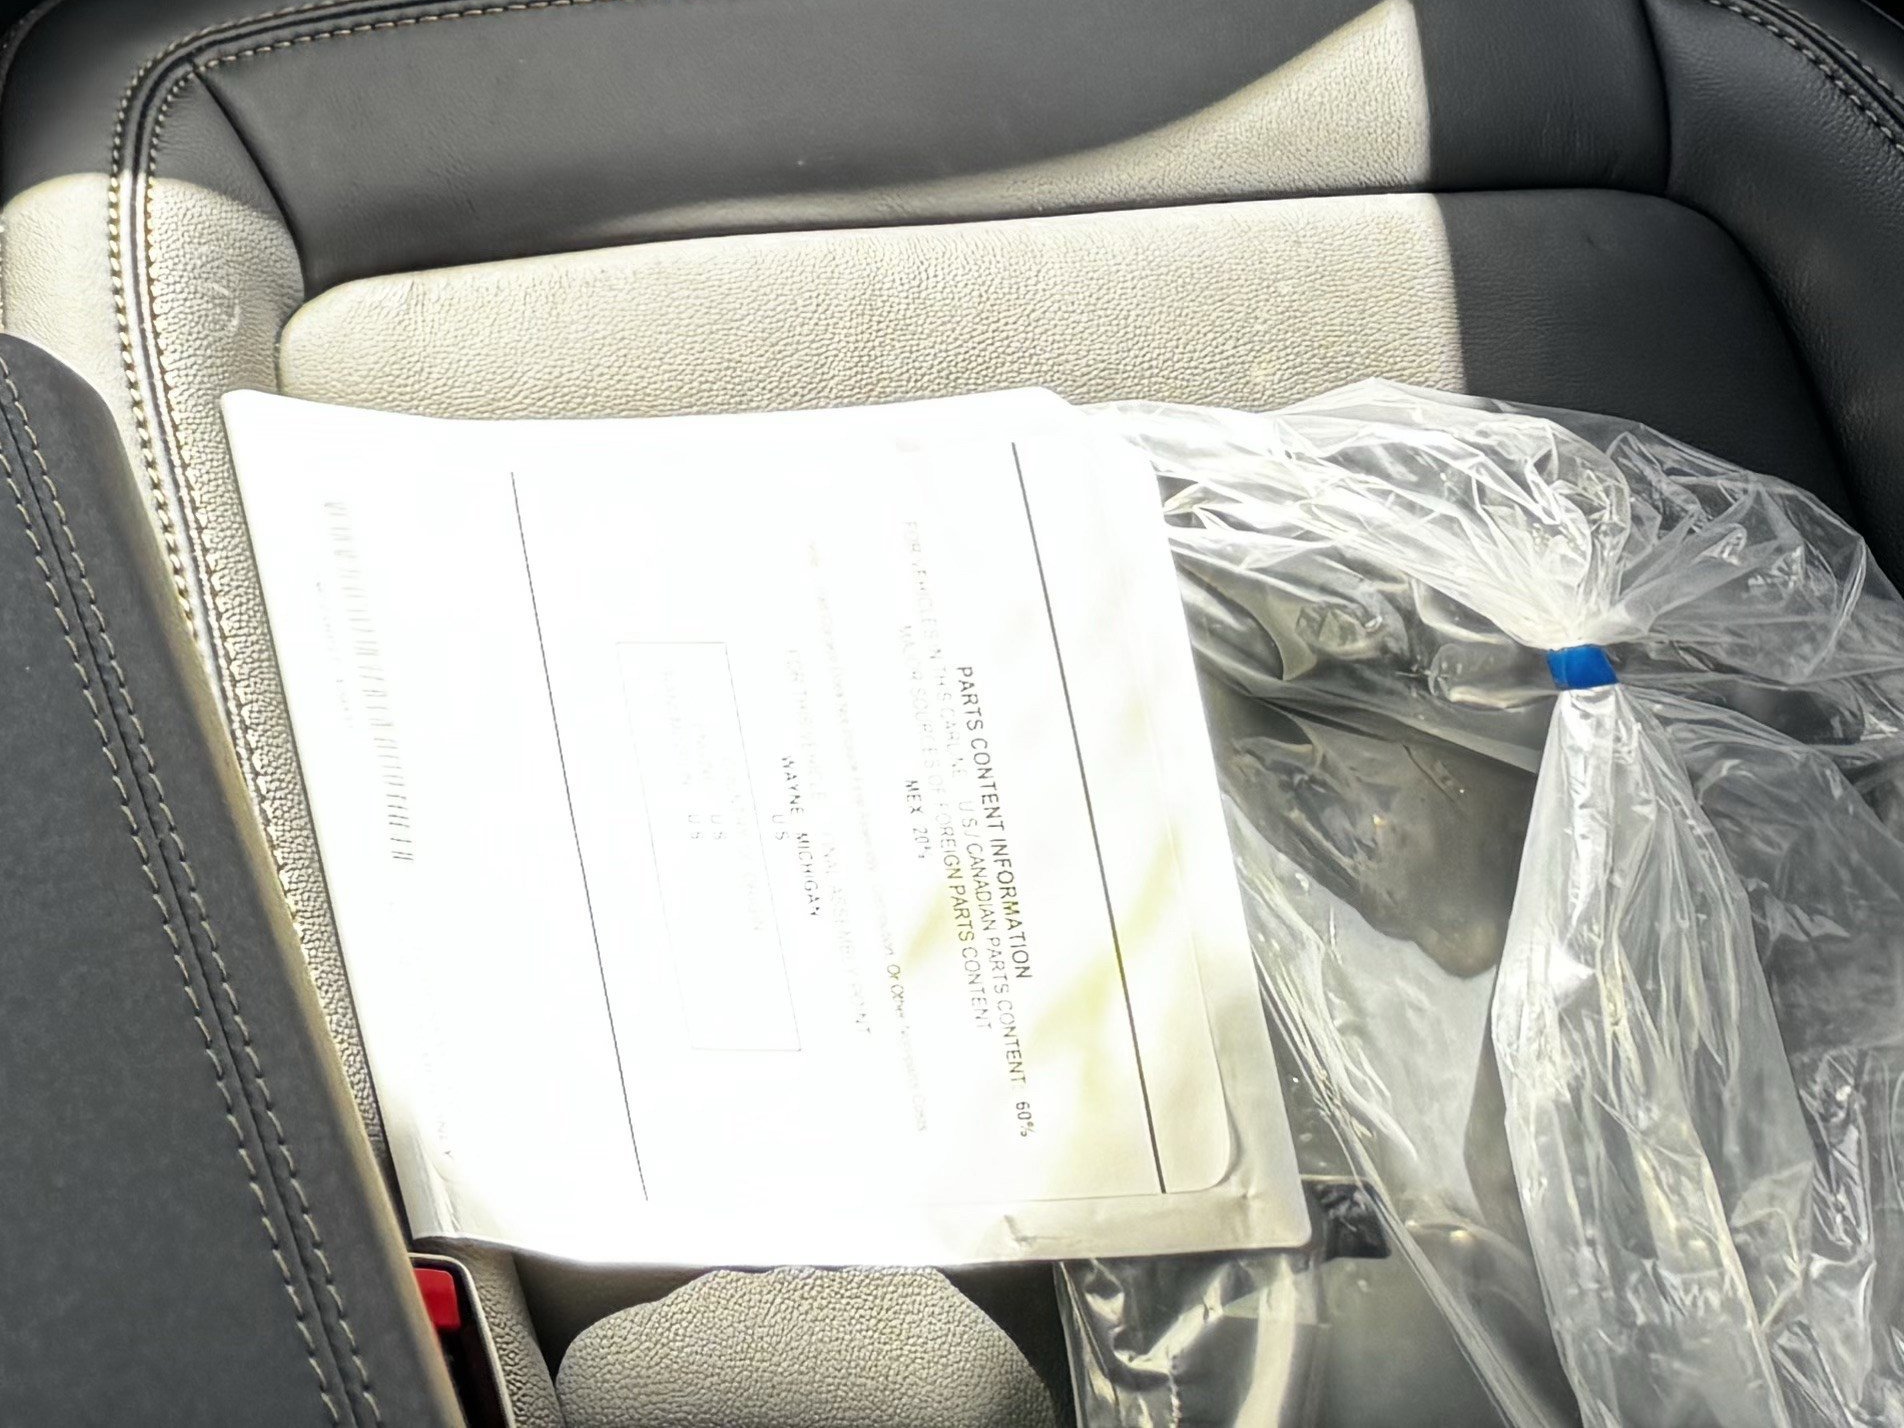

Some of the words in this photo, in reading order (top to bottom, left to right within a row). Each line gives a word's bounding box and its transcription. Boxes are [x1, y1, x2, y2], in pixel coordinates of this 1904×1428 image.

[780, 756, 803, 816] WAYNE
[794, 832, 823, 916] MICHIGAN
[903, 779, 923, 815] MEX
[955, 666, 983, 730] PARTS
[969, 738, 1002, 828] CONTENT
[988, 838, 1032, 979] INFORMATION
[932, 801, 962, 879] FOREIGN
[948, 884, 974, 942] PARTS
[886, 964, 900, 980] Or
[960, 946, 991, 1030] CONTENT
[965, 843, 997, 930] CANADIAN
[984, 937, 1010, 994] PARTS
[1014, 1101, 1035, 1138] 60%
